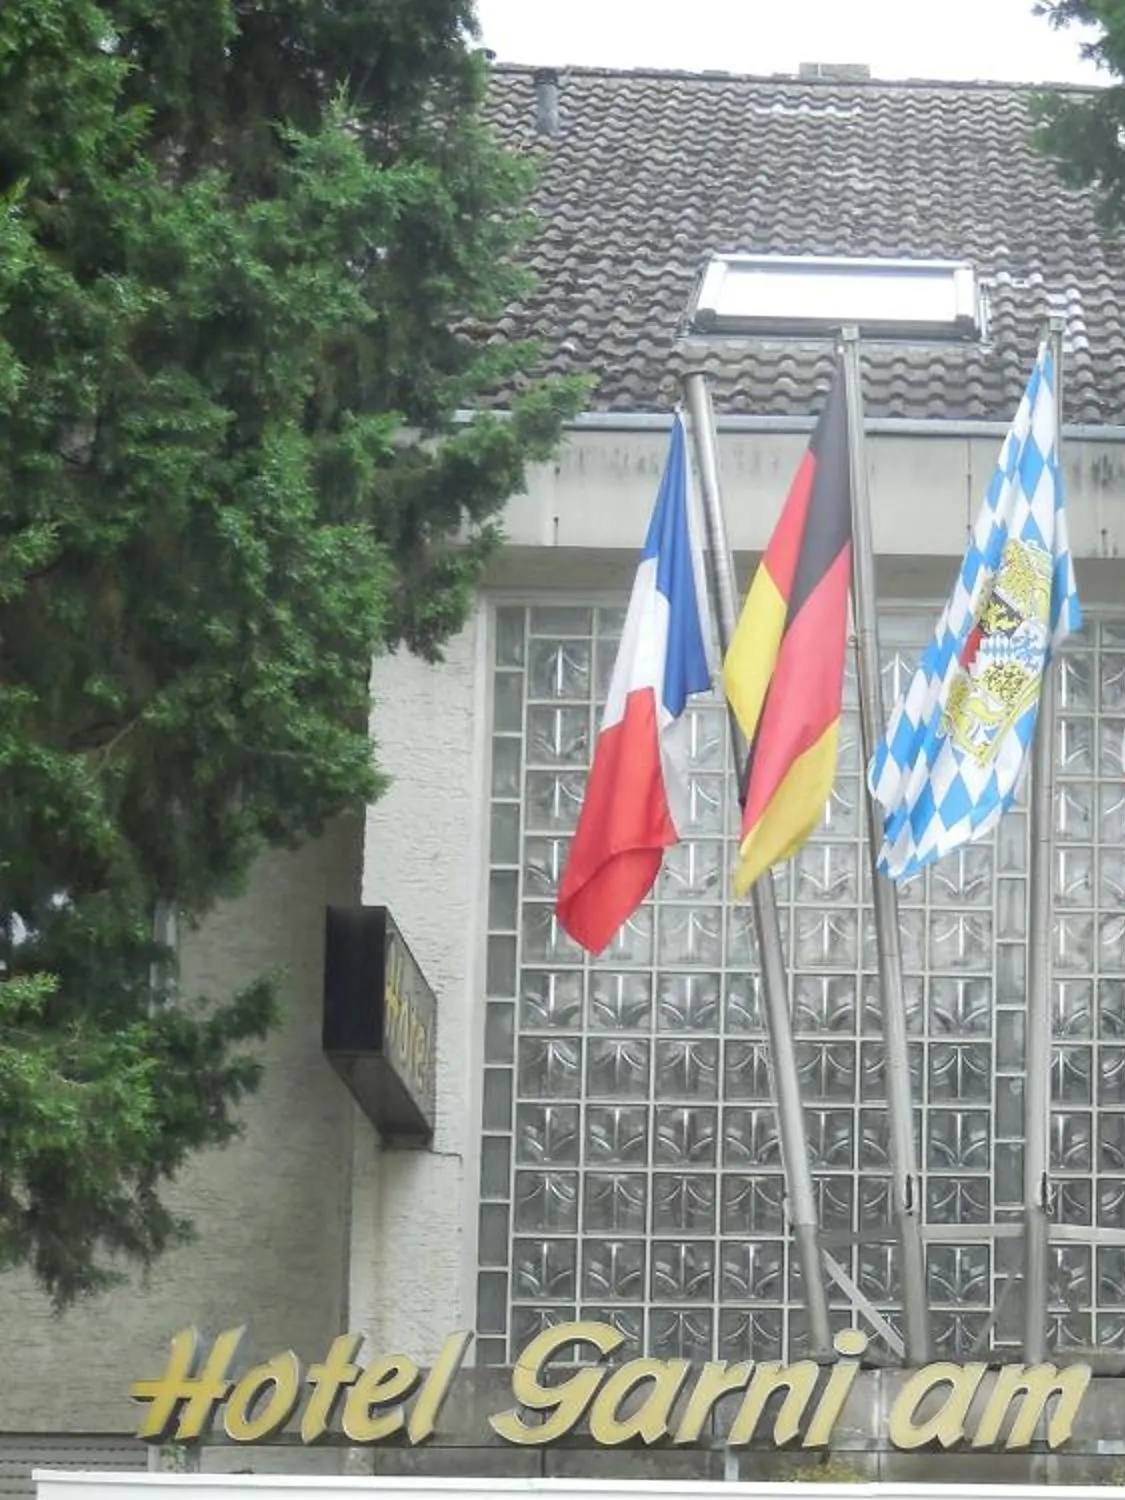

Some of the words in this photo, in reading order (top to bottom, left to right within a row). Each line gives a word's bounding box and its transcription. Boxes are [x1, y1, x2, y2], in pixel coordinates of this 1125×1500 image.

[130, 1325, 475, 1446] Hotel
[487, 1320, 869, 1448] Garni
[887, 1357, 1093, 1450] am
